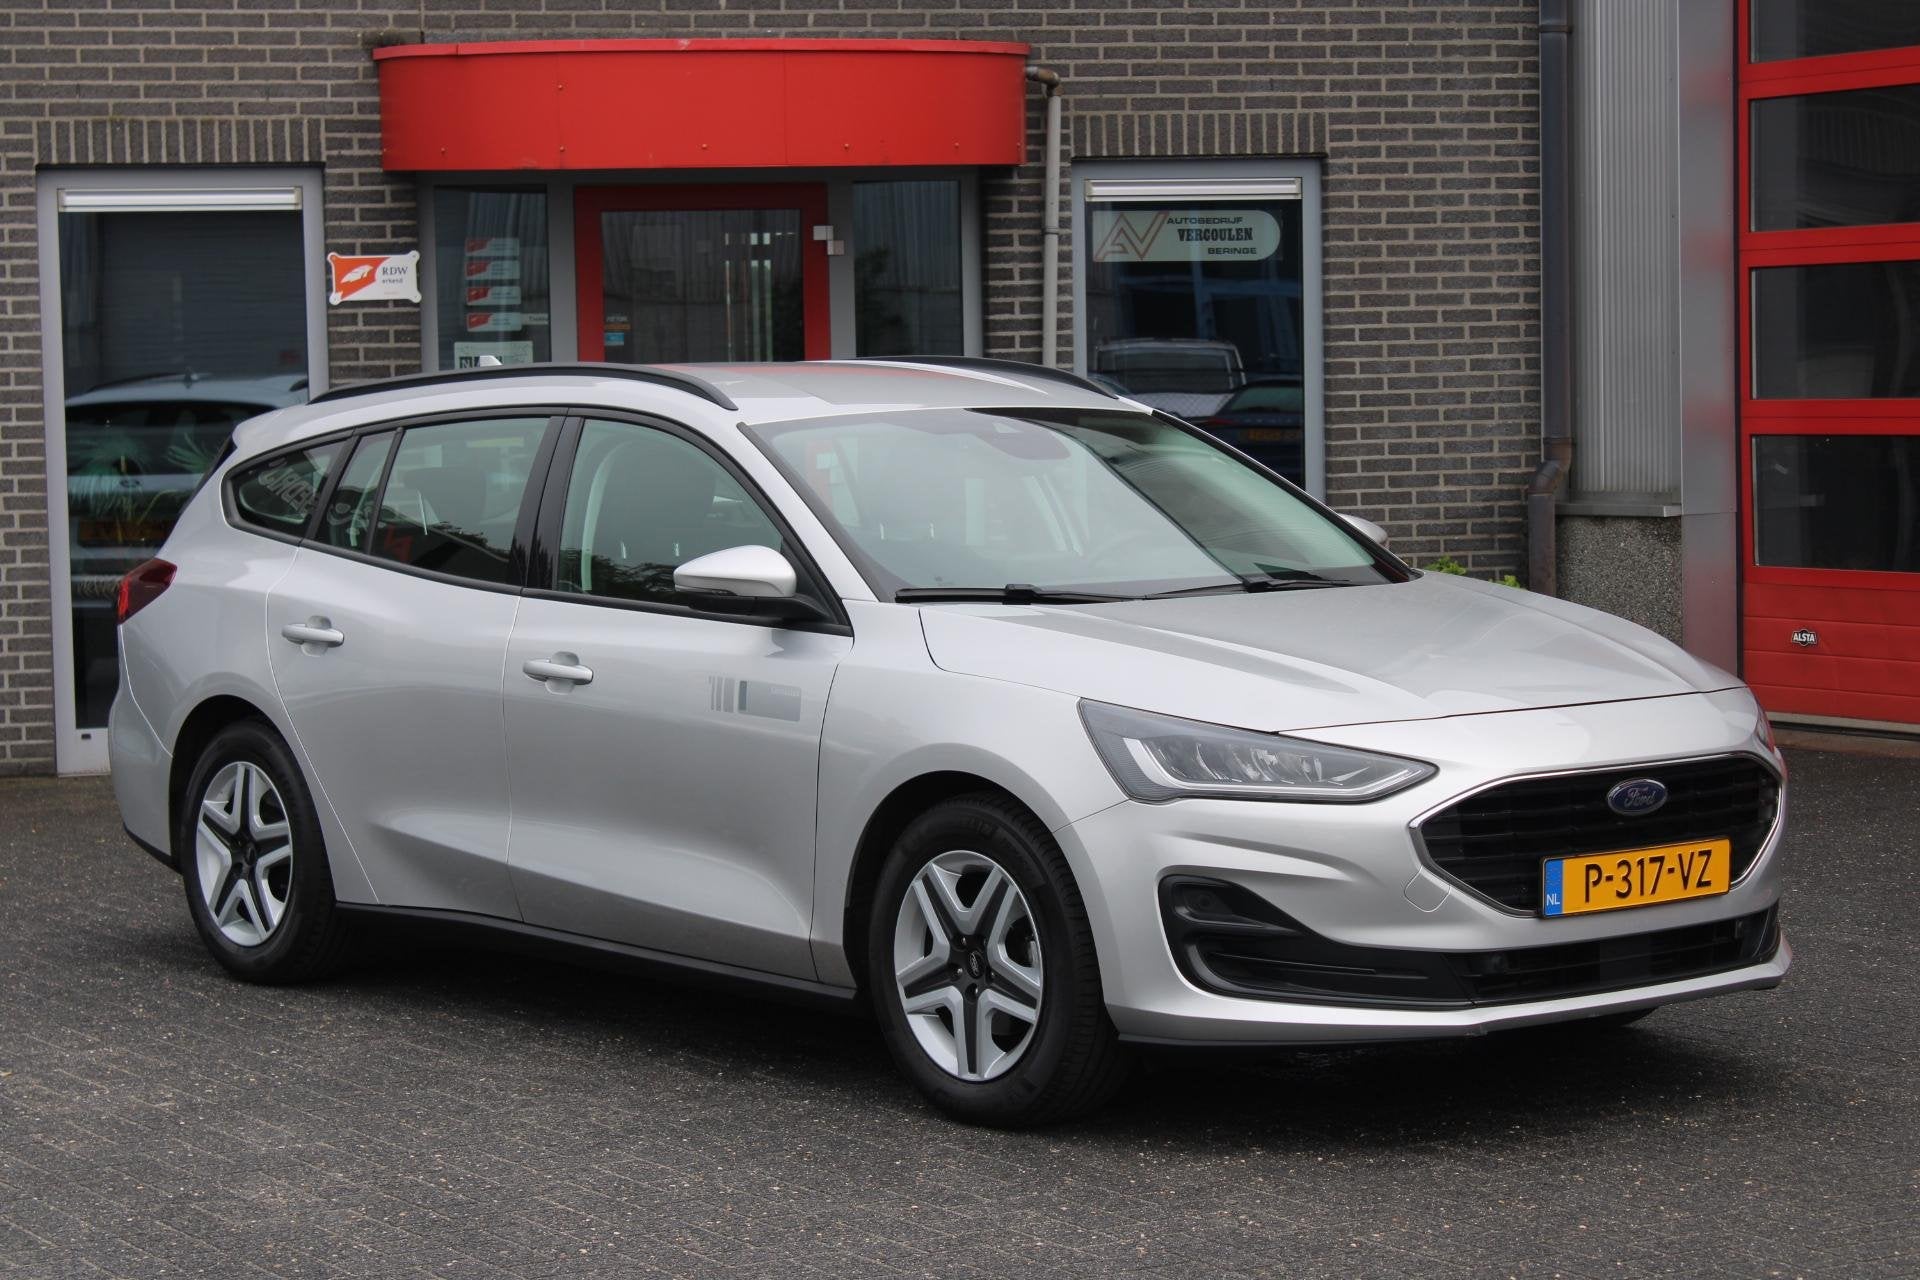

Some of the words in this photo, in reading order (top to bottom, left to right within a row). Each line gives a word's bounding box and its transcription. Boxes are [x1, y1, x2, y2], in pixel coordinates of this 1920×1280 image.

[1177, 227, 1253, 242] VERCOULEN
[382, 266, 408, 275] RDW
[1792, 632, 1815, 642] ALSTA
[1624, 786, 1656, 807] Ford
[1584, 849, 1712, 903] P-317-VZ
[1546, 893, 1560, 906] NL
